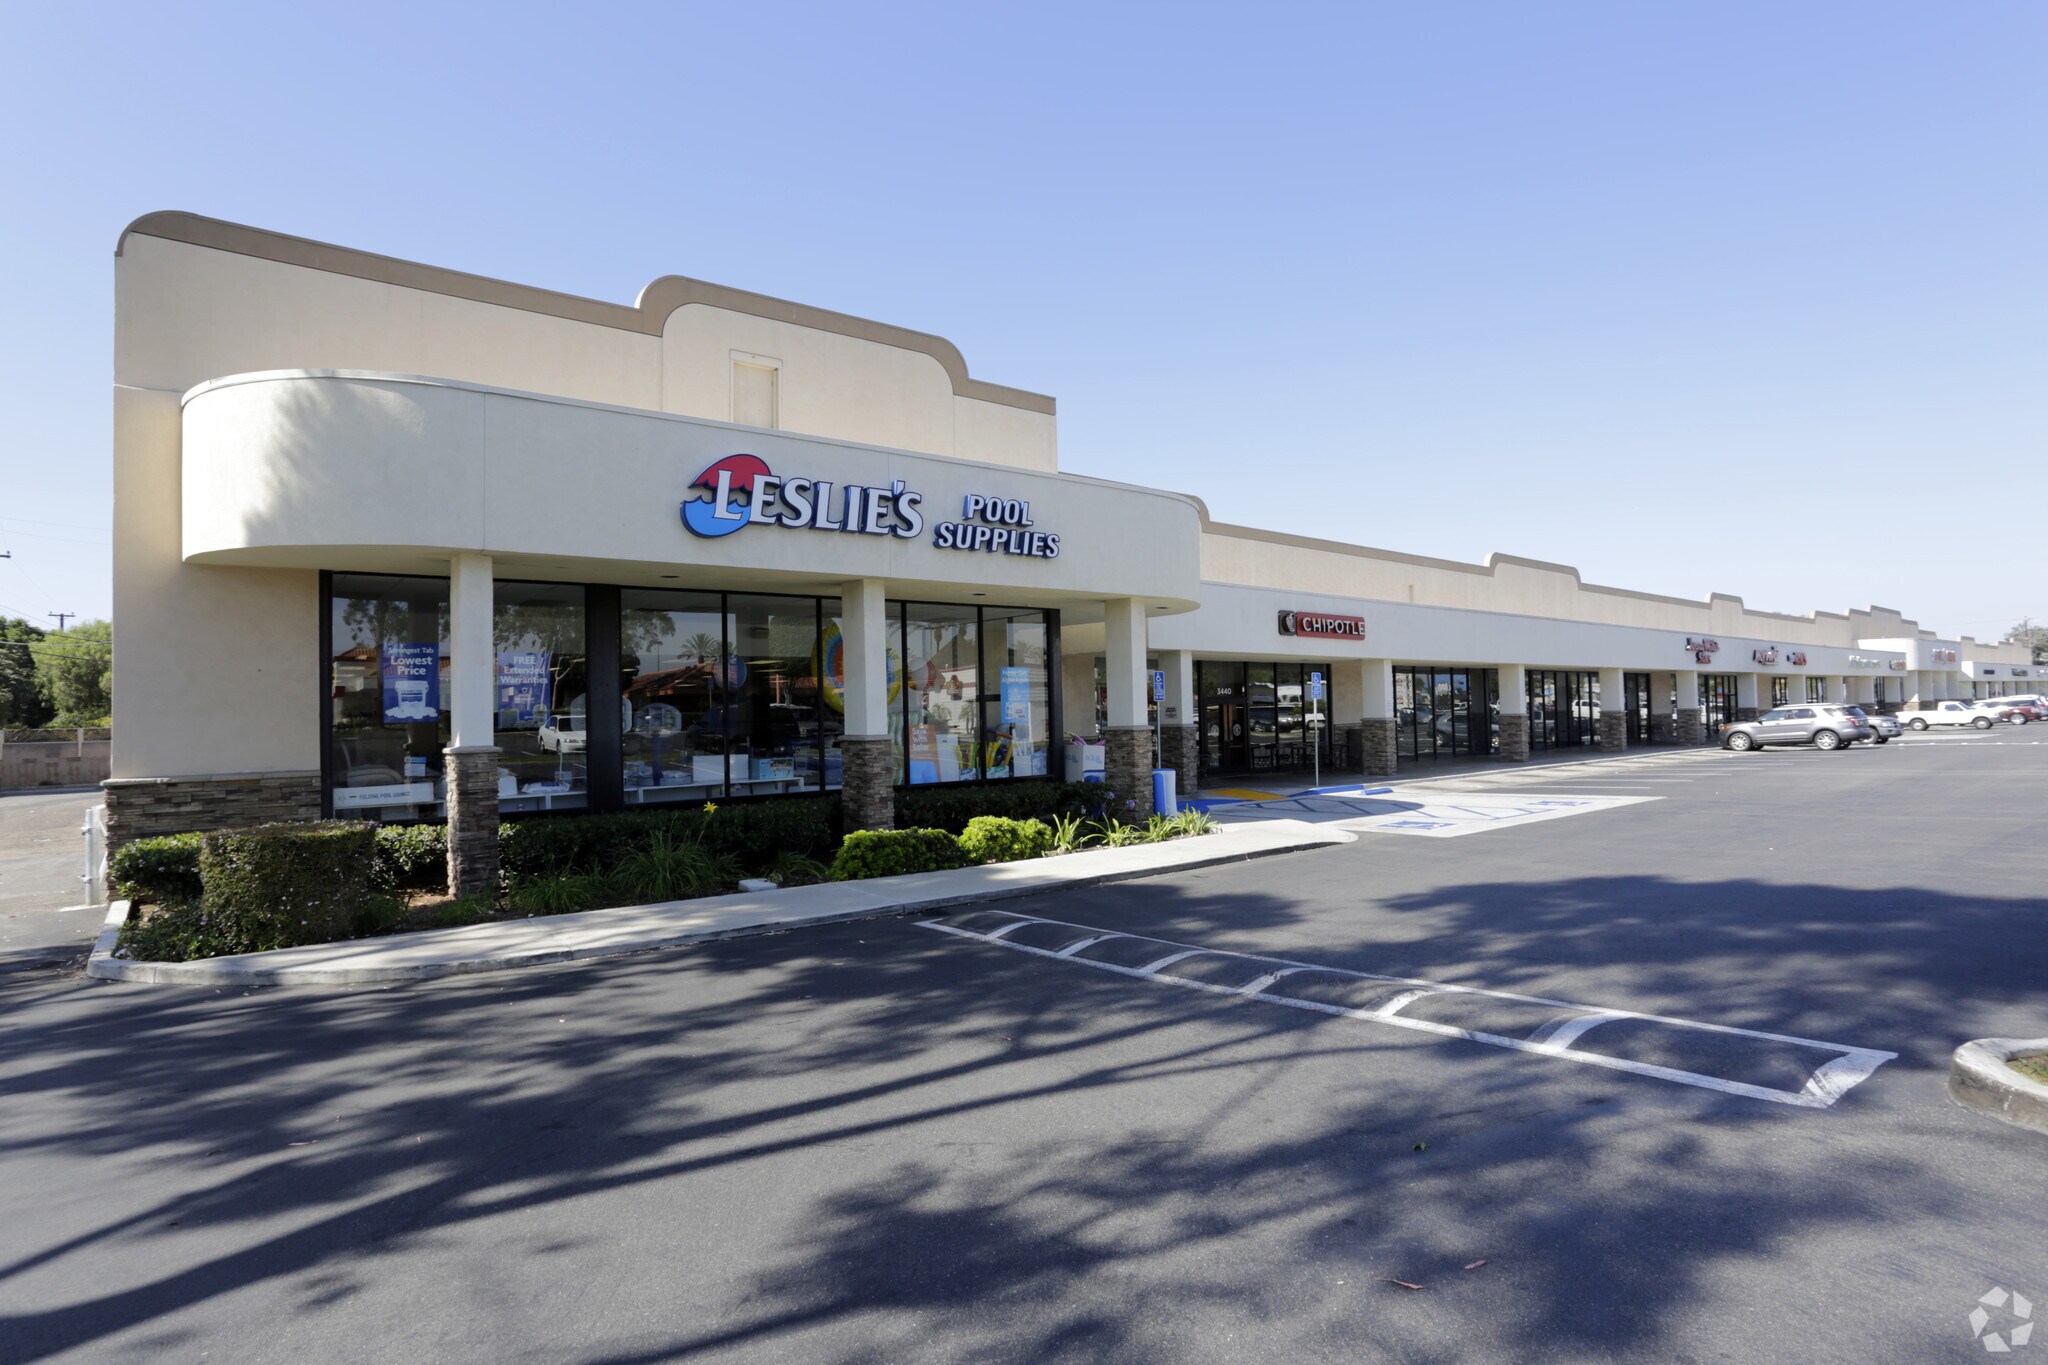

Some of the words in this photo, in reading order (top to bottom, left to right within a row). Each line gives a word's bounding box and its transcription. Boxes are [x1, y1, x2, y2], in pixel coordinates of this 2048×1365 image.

[712, 468, 924, 539] LESLIE'S
[963, 494, 1033, 527] POOL
[933, 521, 1061, 559] SUPPLIES
[1302, 617, 1365, 635] CHIPOTLE
[390, 655, 433, 665] Lowest
[513, 656, 536, 665] FREE
[397, 665, 427, 675] Price
[504, 666, 546, 674] Extended
[500, 675, 549, 684] Warranties
[1216, 687, 1232, 695] 3440
[911, 727, 927, 735] Save
[912, 734, 928, 743] with
[912, 743, 929, 751] Solar
